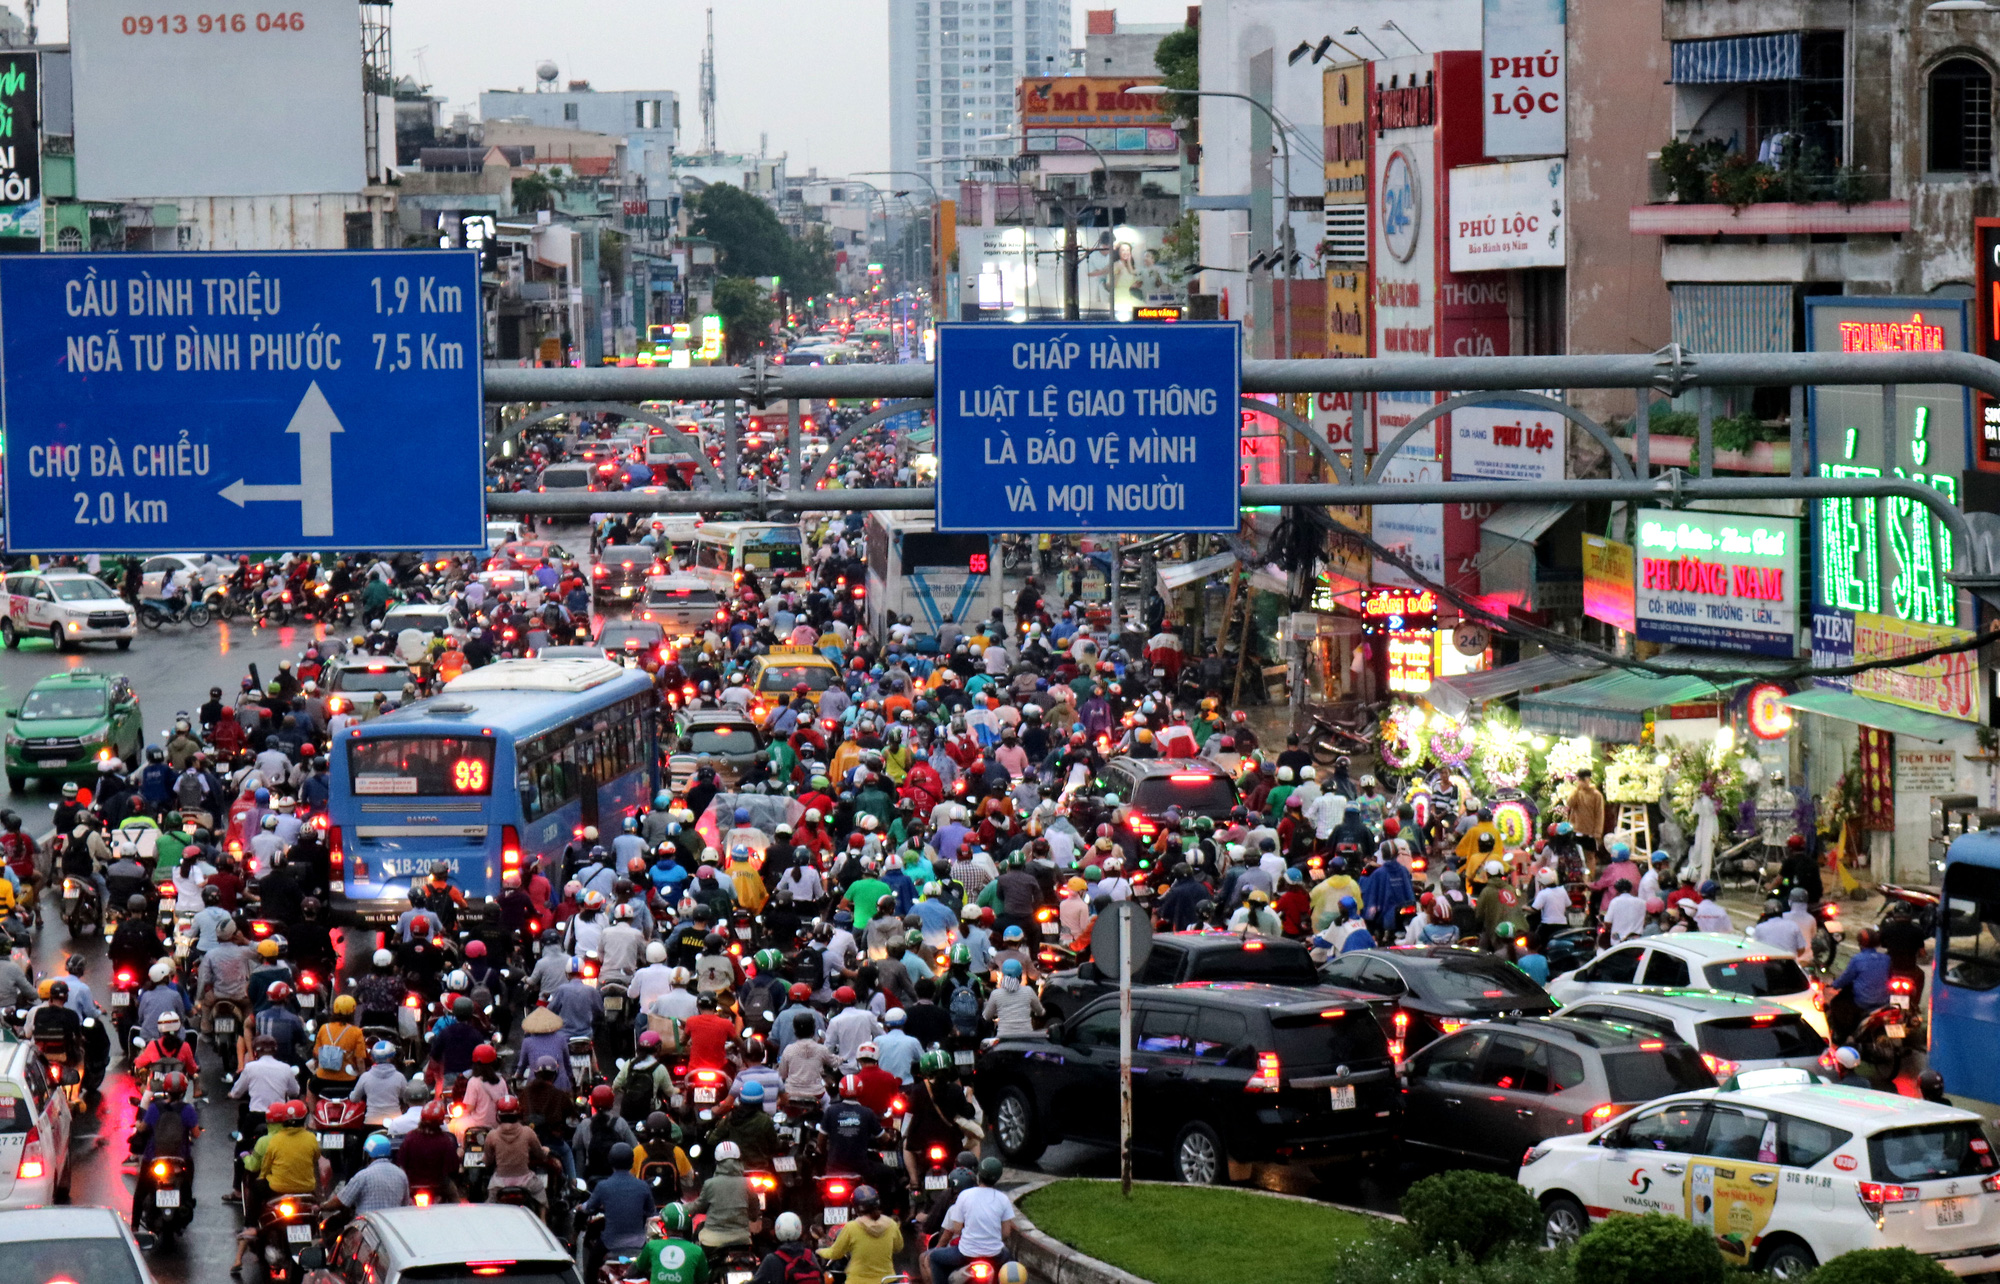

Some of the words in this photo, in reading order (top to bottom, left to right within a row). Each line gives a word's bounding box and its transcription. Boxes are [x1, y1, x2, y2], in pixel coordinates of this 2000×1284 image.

[122, 14, 188, 36] 0913
[198, 13, 246, 34] 916
[256, 12, 305, 33] 046
[1489, 49, 1559, 79] PHÚ
[1492, 86, 1559, 119] LỘC
[1459, 214, 1496, 238] PHÚ
[1502, 212, 1539, 238] LỘC
[65, 266, 118, 317] CẦU
[128, 271, 193, 315] BÌNH
[202, 271, 281, 321] TRIỆU
[371, 277, 410, 316] 1,9
[420, 276, 463, 313] Km
[67, 328, 122, 373] NGÃ
[130, 333, 166, 372] TƯ
[175, 326, 240, 371] BÌNH
[250, 323, 342, 370] PHƯỚC
[373, 333, 411, 373] 7,5
[421, 333, 464, 369] Km
[1012, 333, 1080, 369] CHẤP
[1090, 335, 1160, 369] HÀNH
[1840, 322, 1901, 352] TRUNG
[959, 385, 1019, 422] LUẬT
[1028, 384, 1058, 422] LỆ
[1067, 389, 1125, 416] GIAO
[1133, 384, 1217, 416] THÔNG
[984, 430, 1017, 464] LÀ
[1027, 429, 1076, 465] BẢO
[1087, 433, 1119, 469] VỆ
[1129, 428, 1196, 464] MÌNH
[1492, 421, 1522, 447] PHÚ
[1525, 422, 1553, 454] LỘC
[29, 444, 81, 484] CHỢ
[90, 438, 125, 477] BÀ
[132, 430, 210, 477] CHIỂU
[74, 492, 115, 527] 2,0
[124, 493, 168, 524] km
[1005, 478, 1037, 511] VÀ
[1048, 485, 1094, 517] MỌI
[1106, 475, 1185, 511] NGƯỜI
[1732, 564, 1784, 601] NAM
[1666, 598, 1696, 617] HOÀNH
[1938, 651, 1972, 718] 30
[456, 761, 484, 790] 93
[657, 1271, 682, 1283] Grab
